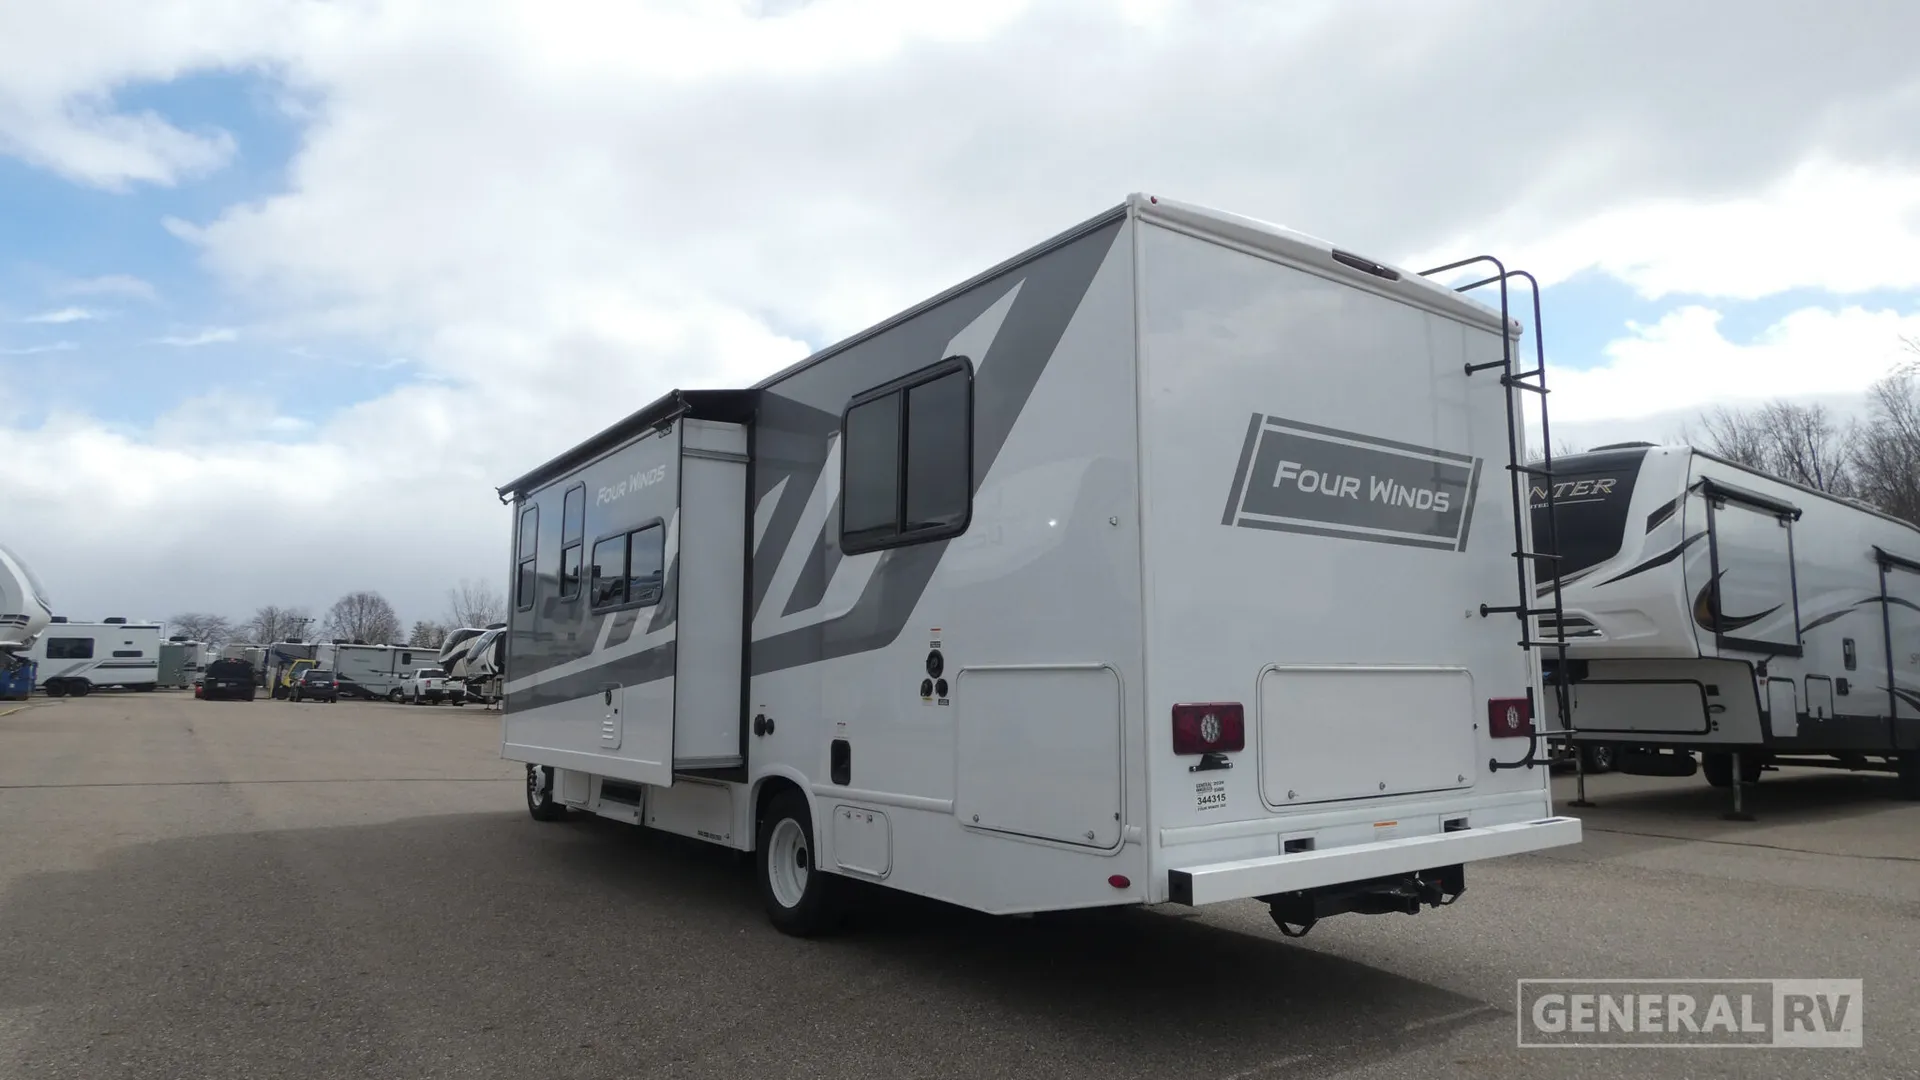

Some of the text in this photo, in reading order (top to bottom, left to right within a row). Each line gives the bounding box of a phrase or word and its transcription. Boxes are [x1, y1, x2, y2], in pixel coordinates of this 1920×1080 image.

[596, 464, 666, 507] FOUR WINDS
[1272, 460, 1450, 512] FOUR WINDS
[1197, 793, 1226, 806] 344315
